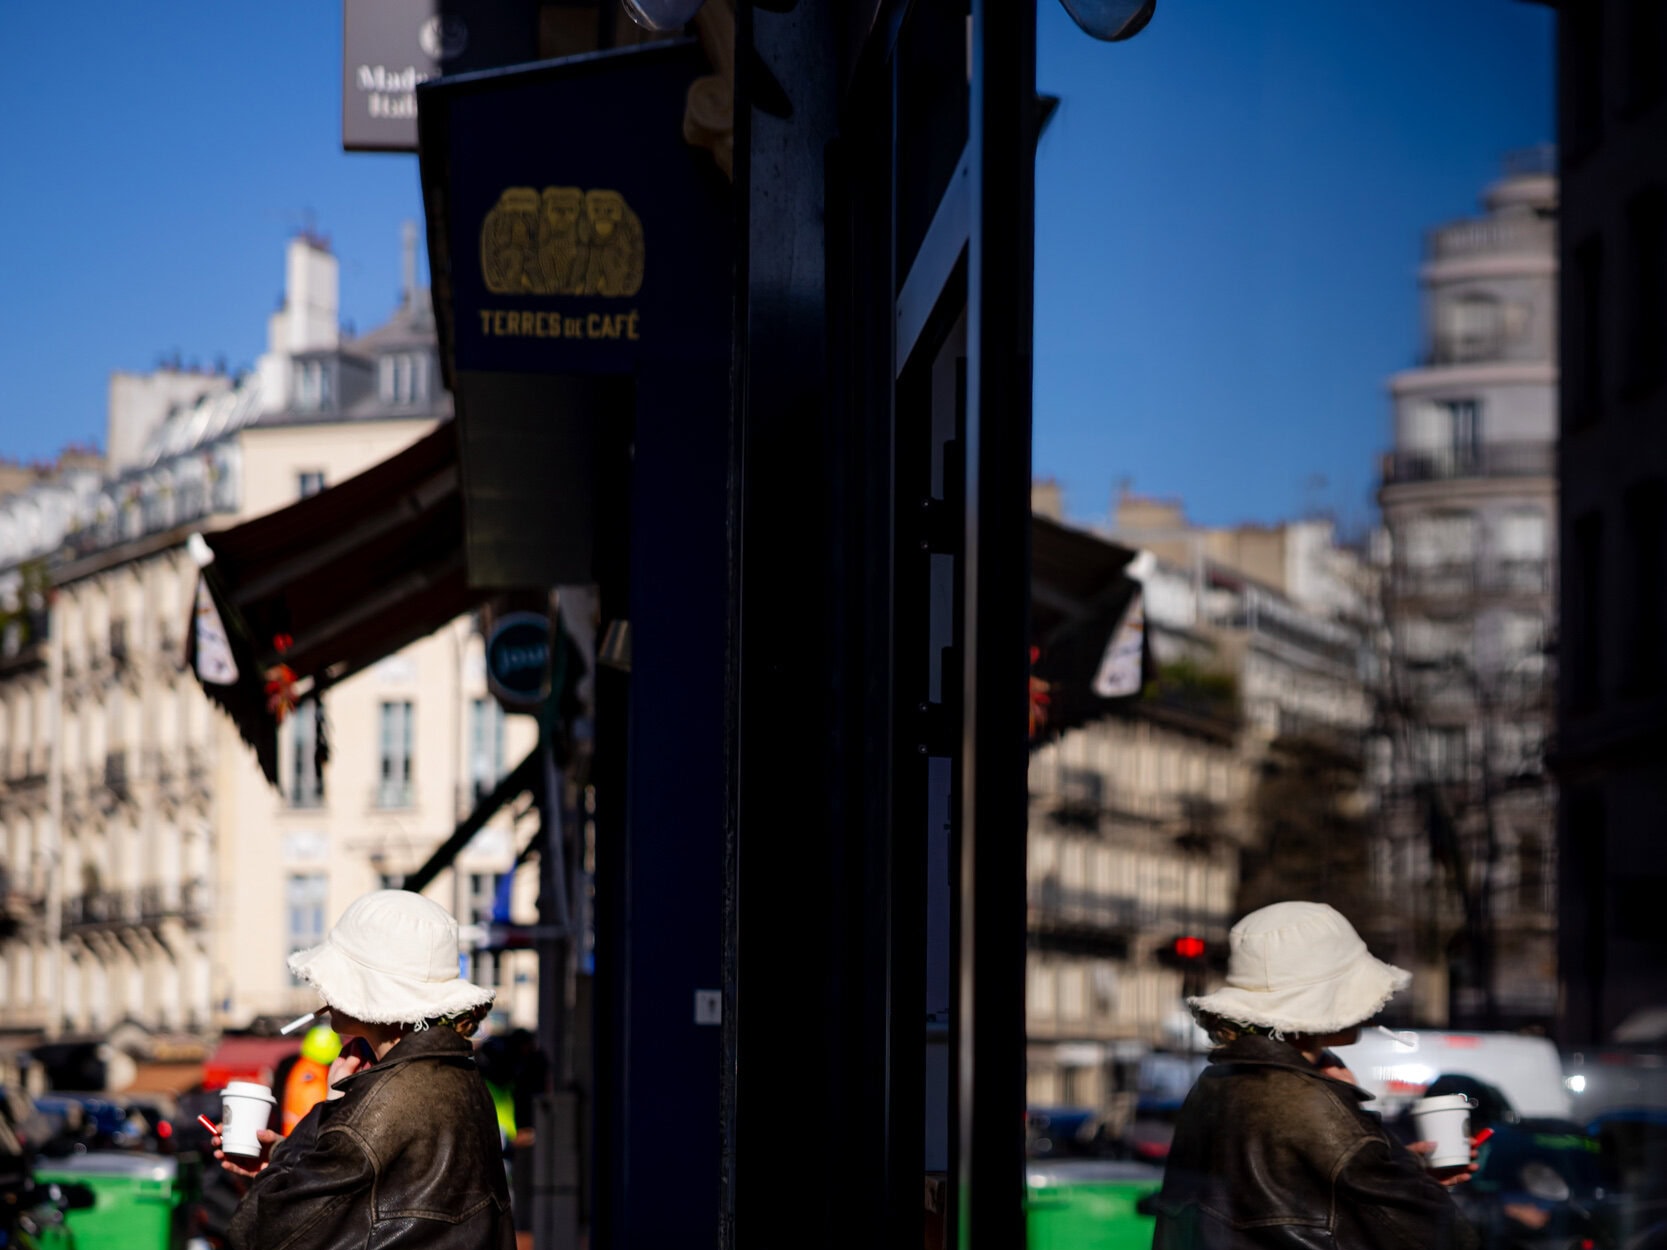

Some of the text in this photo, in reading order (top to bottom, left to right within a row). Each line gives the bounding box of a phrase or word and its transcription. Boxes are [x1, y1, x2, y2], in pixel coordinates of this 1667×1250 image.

[480, 308, 640, 341] TERRES DE CAFÉ
